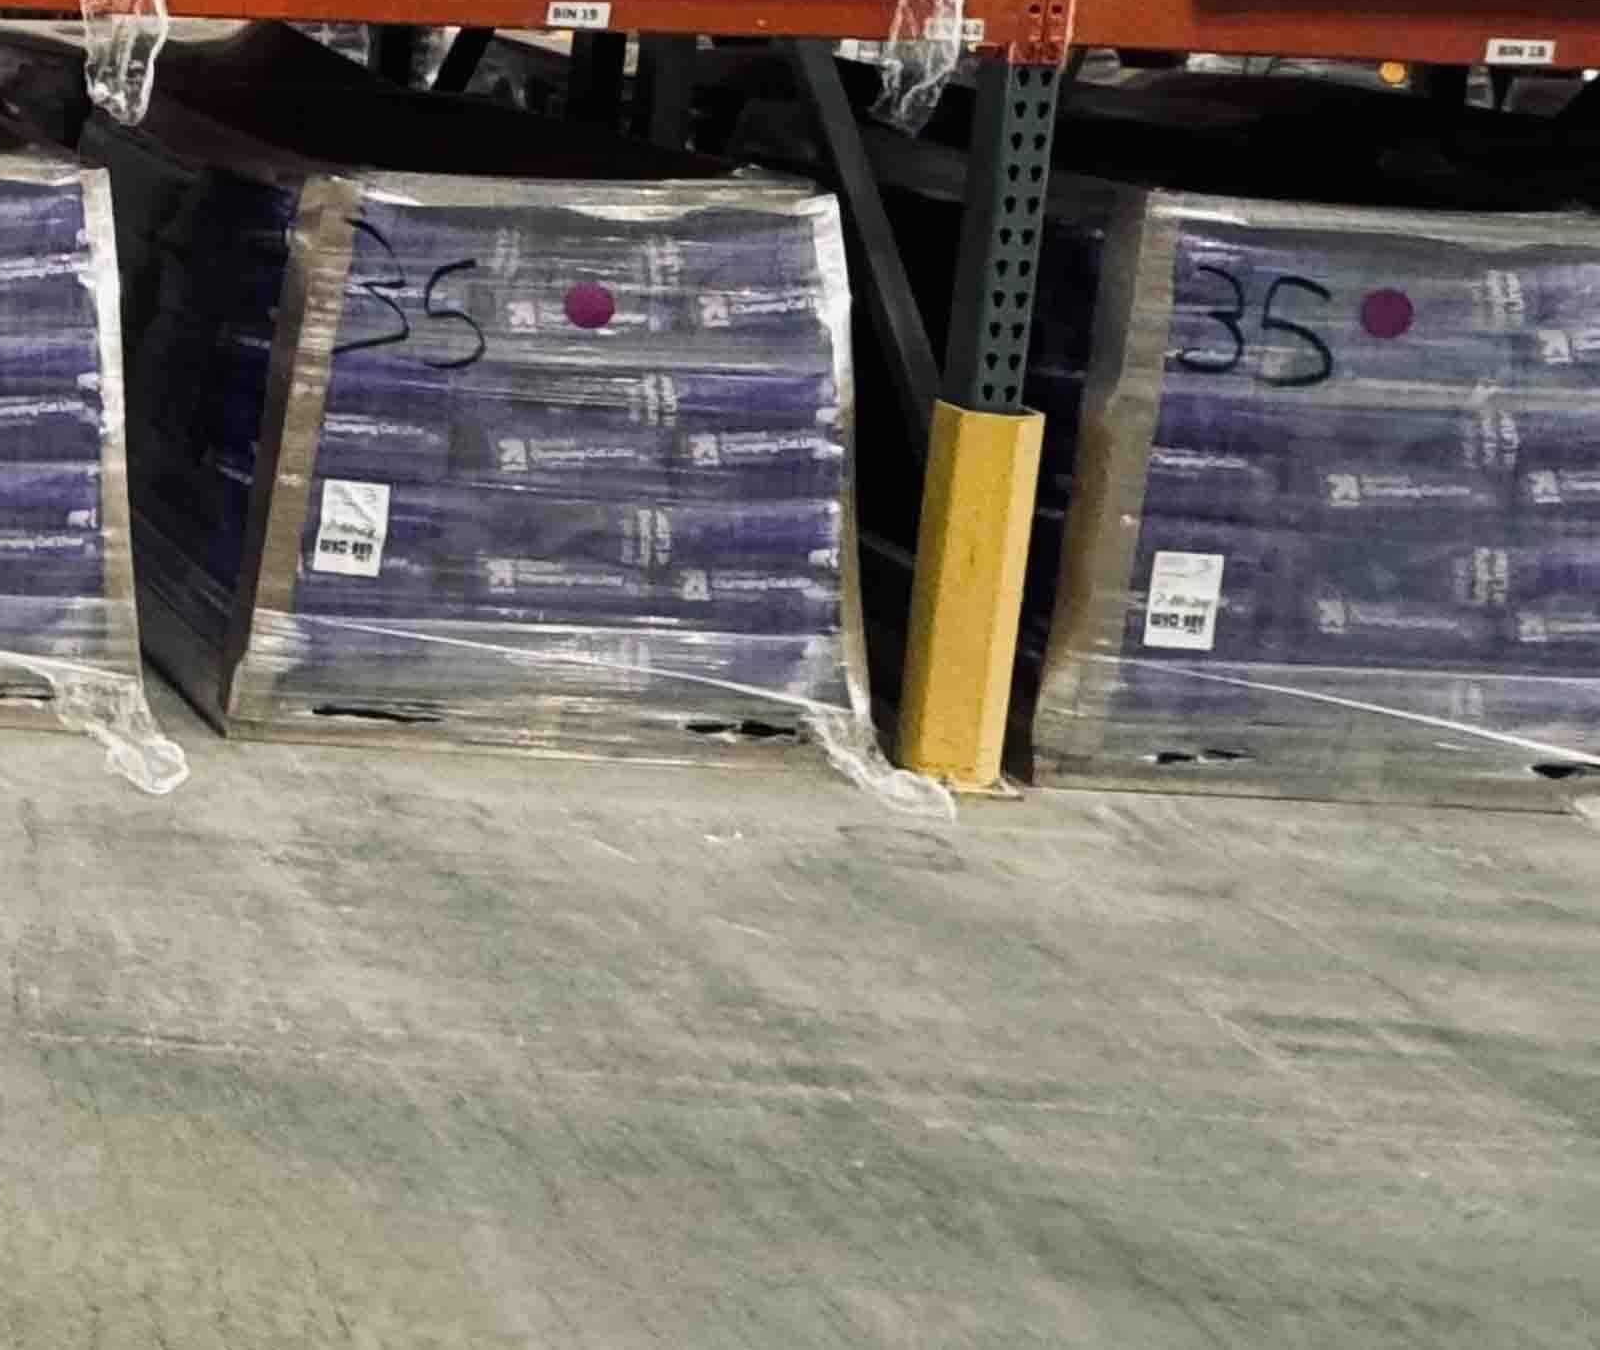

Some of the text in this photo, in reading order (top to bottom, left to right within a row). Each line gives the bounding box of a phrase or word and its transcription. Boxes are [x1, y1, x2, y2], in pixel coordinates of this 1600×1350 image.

[554, 7, 577, 19] BIN
[1498, 45, 1523, 57] BIN
[331, 217, 487, 369] 35
[1175, 265, 1333, 387] 35
